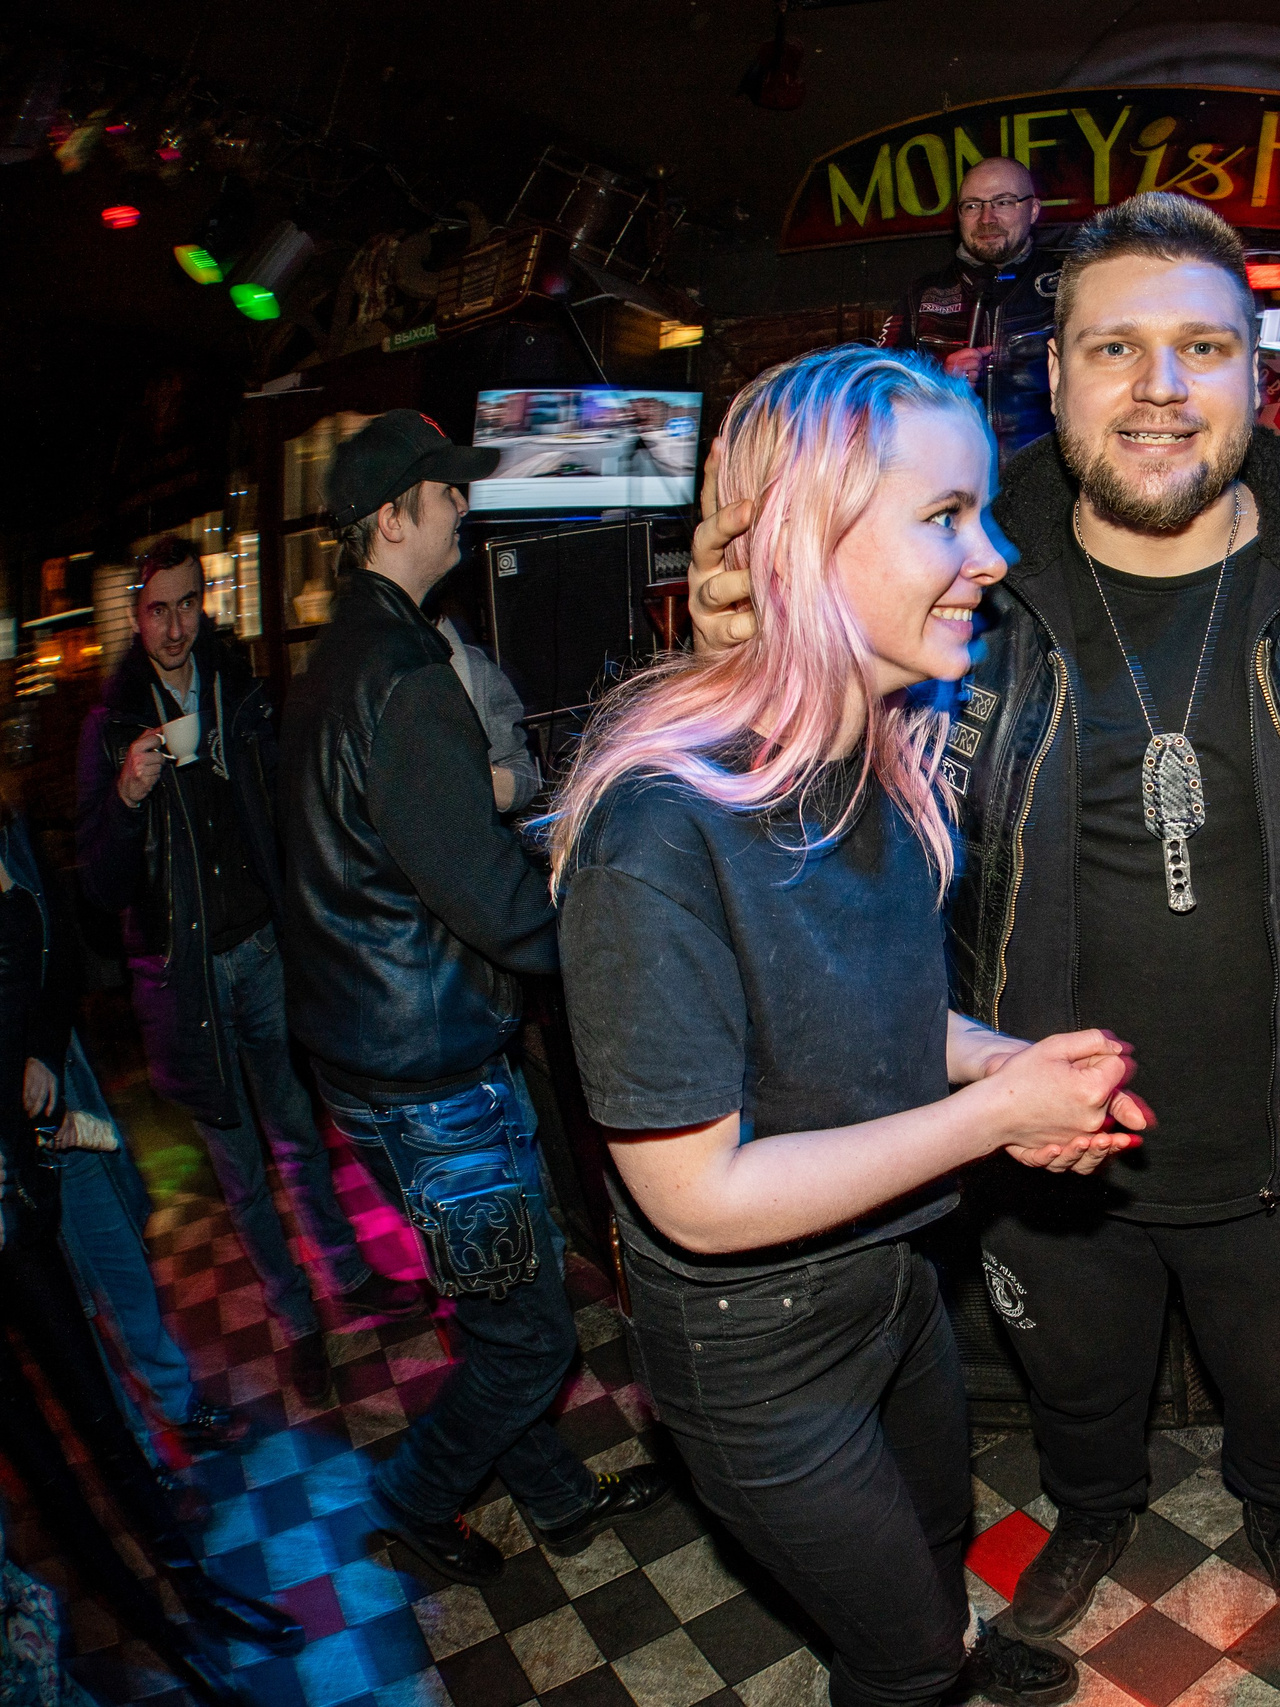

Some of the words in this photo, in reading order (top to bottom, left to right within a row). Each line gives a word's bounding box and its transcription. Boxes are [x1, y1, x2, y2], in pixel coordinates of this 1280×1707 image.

[828, 105, 1132, 227] MONEY
[1130, 115, 1245, 201] is
[394, 323, 436, 345] ВЫХОД
